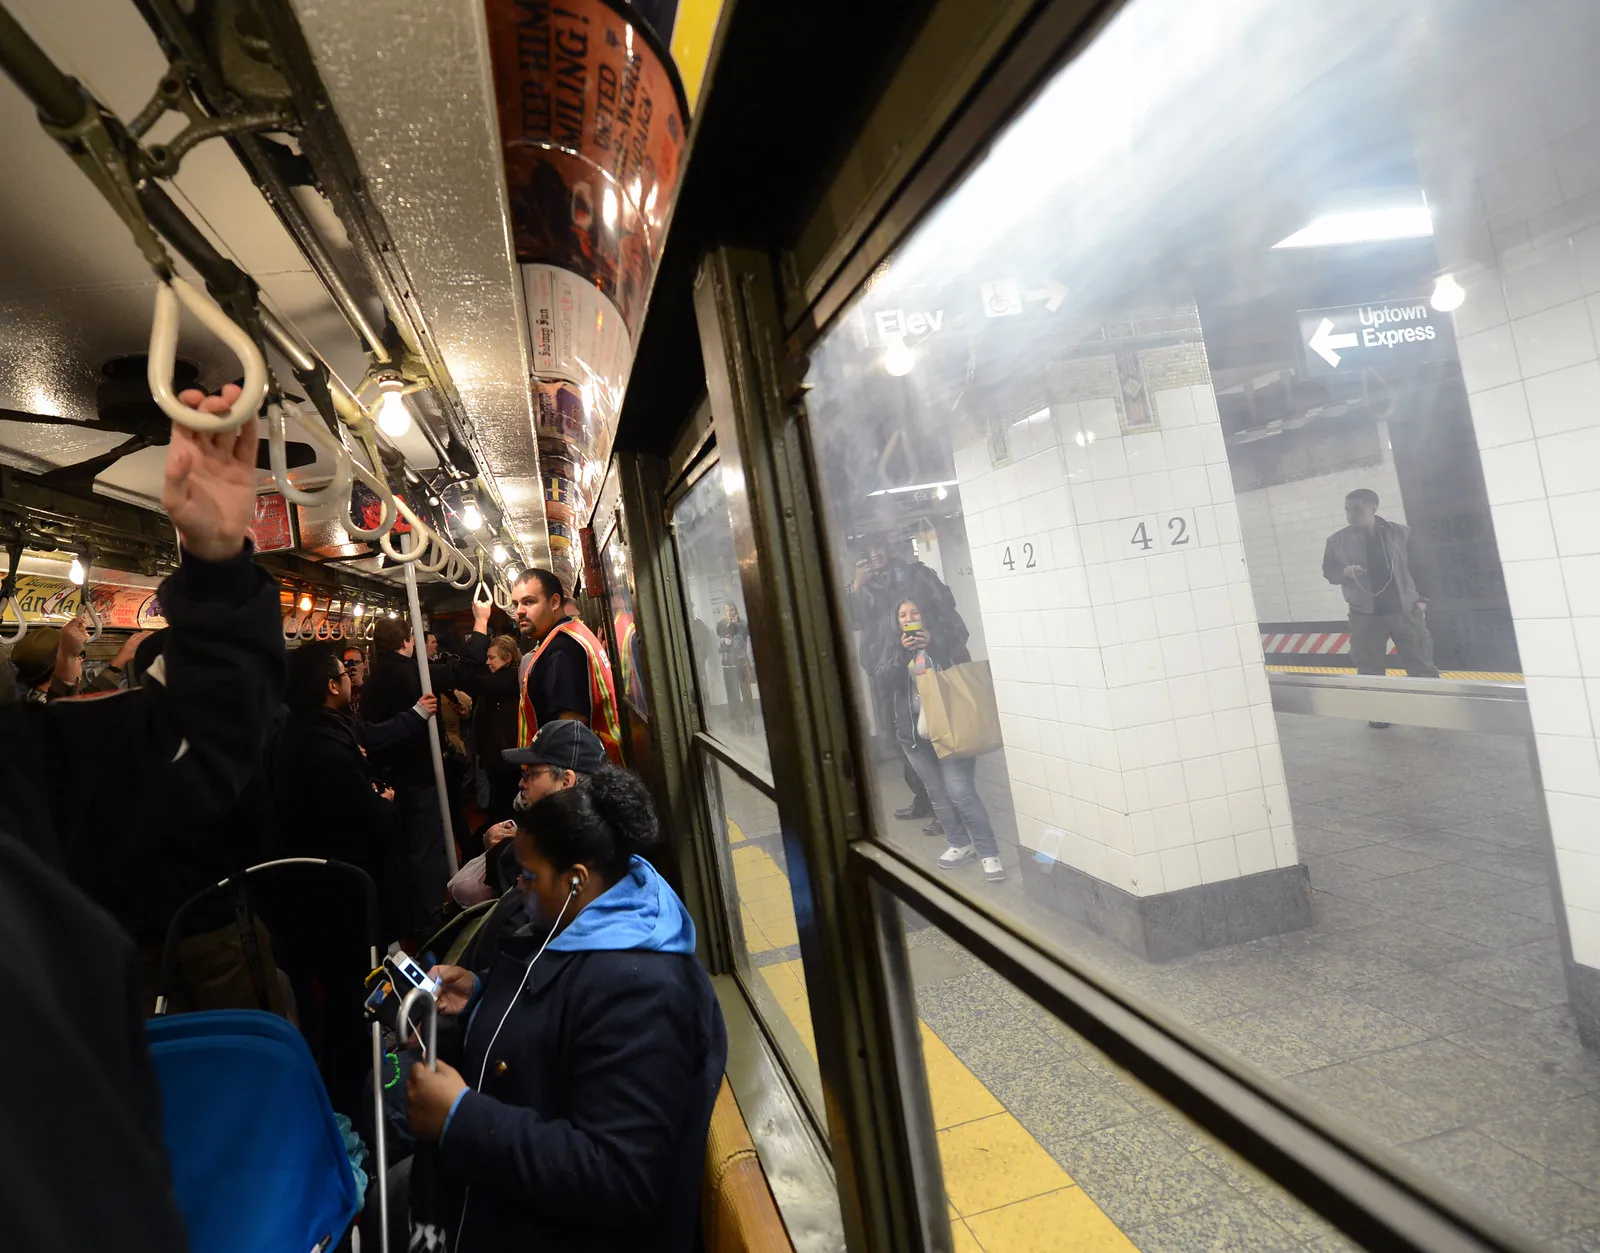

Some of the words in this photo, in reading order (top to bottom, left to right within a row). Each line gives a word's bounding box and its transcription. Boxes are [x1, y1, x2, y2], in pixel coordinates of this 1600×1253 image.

[553, 7, 589, 152] MILING!
[520, 79, 551, 142] EEP
[1358, 305, 1427, 328] Uptown
[1363, 325, 1436, 348] Express
[1131, 517, 1190, 550] 42
[1002, 542, 1037, 571] 42
